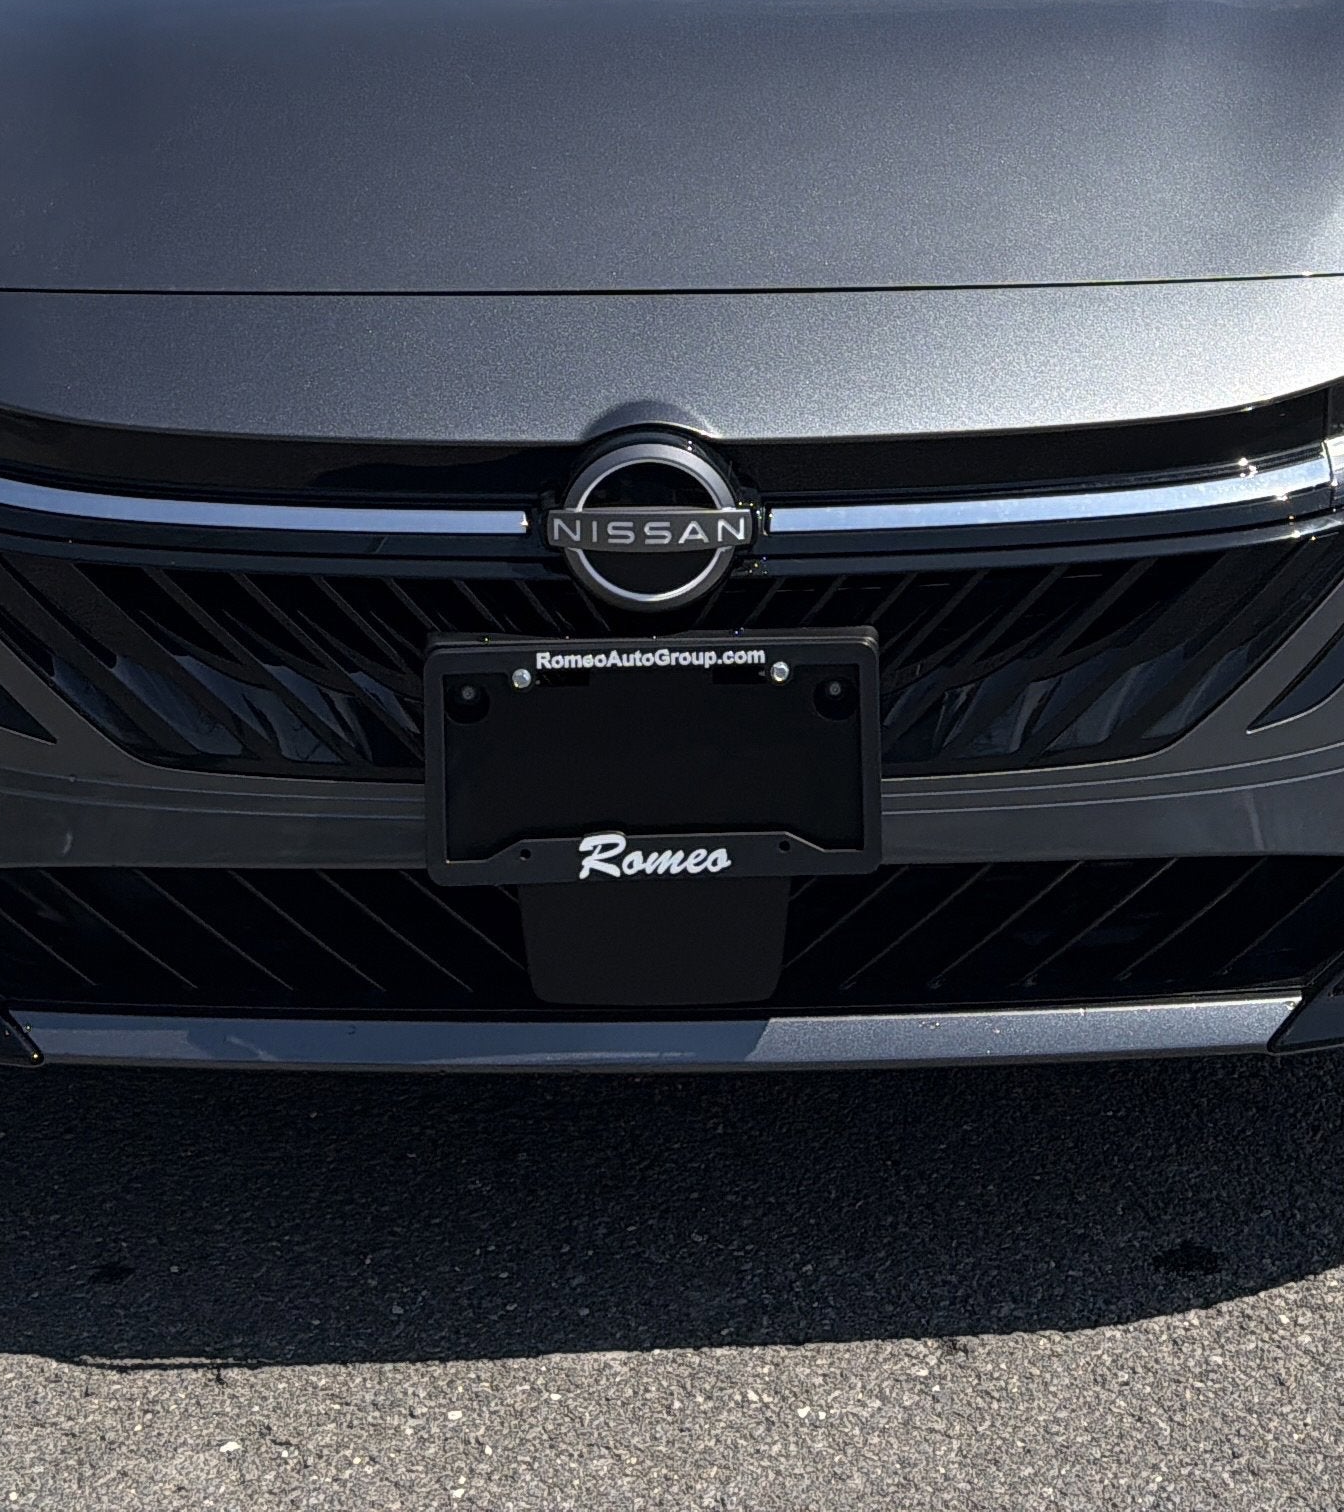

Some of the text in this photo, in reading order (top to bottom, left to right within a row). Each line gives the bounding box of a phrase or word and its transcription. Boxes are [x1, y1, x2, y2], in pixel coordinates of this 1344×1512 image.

[553, 517, 745, 545] NISSAN
[535, 649, 766, 669] RomeoAutoGroup.com
[578, 833, 733, 880] Romeo
